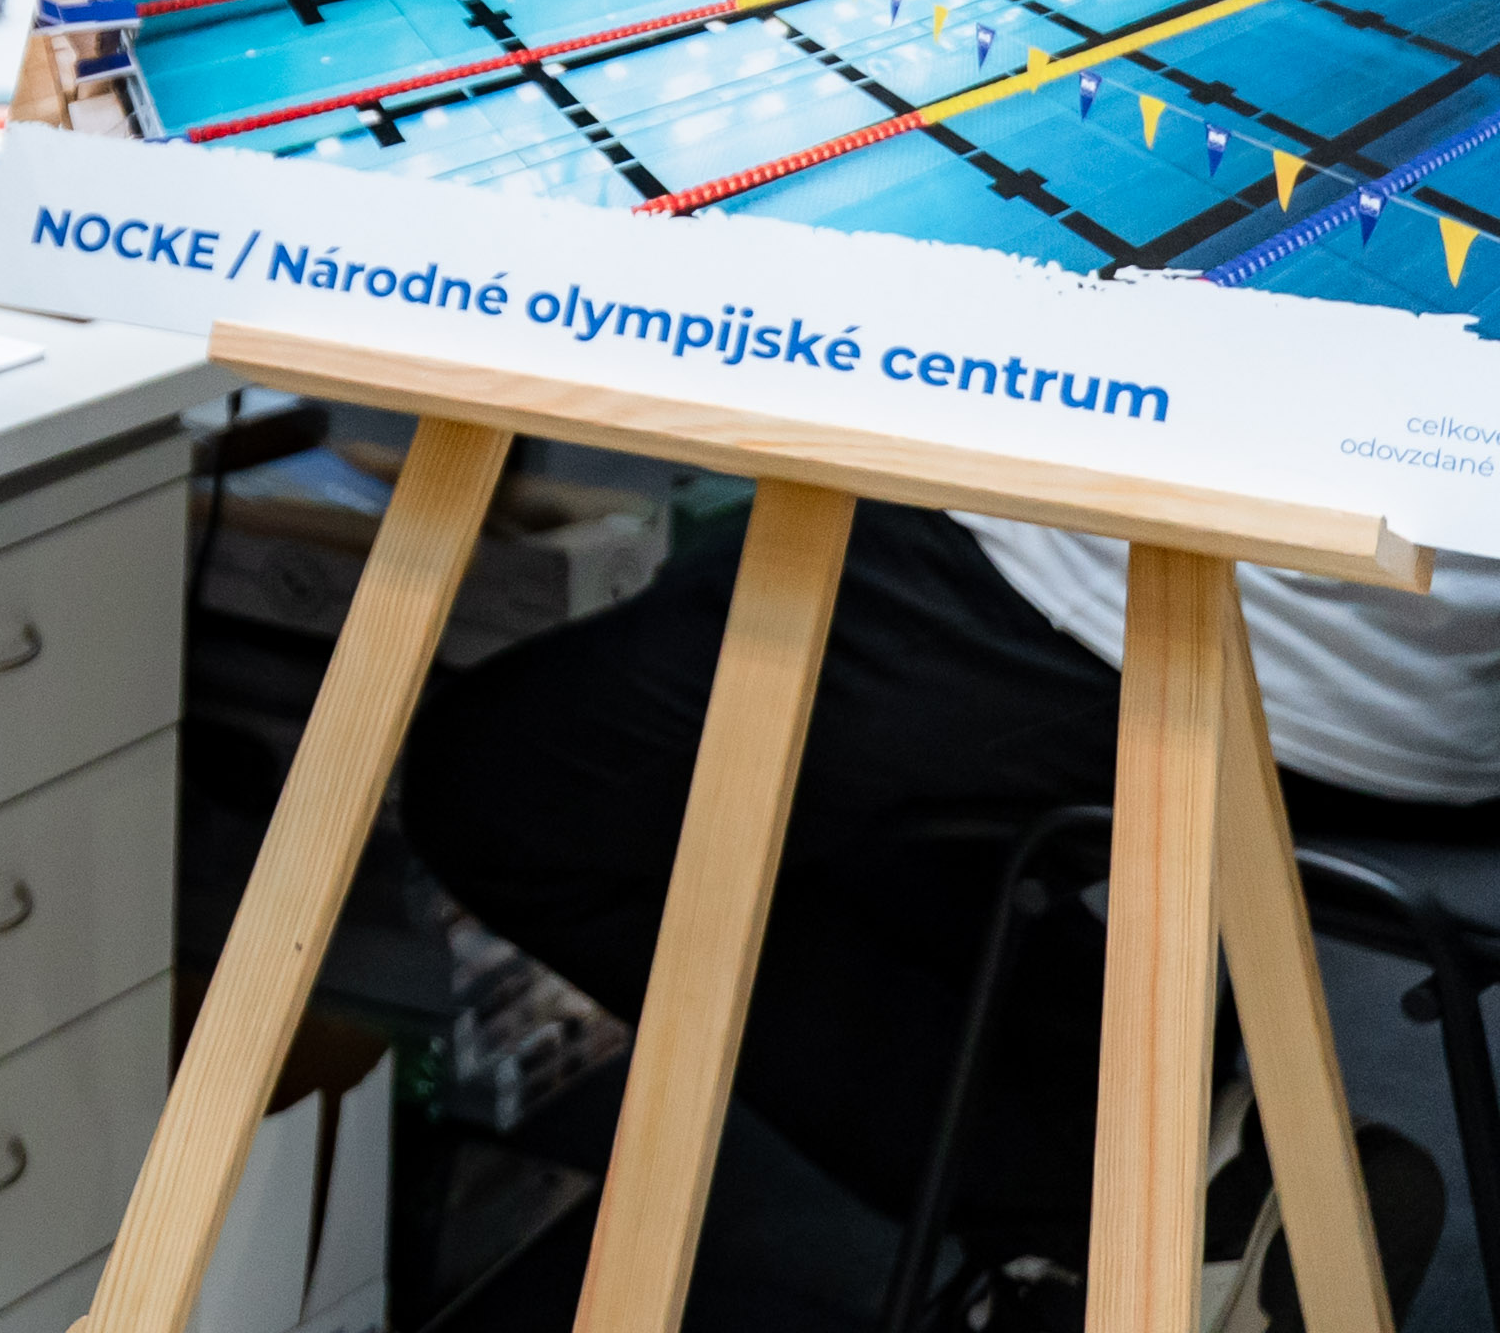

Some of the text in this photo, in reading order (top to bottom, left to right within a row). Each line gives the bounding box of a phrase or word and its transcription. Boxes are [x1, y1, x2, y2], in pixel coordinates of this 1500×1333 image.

[31, 207, 1170, 423] NOCKE / Národné olympijské centrum
[1340, 438, 1494, 478] odovzdané
